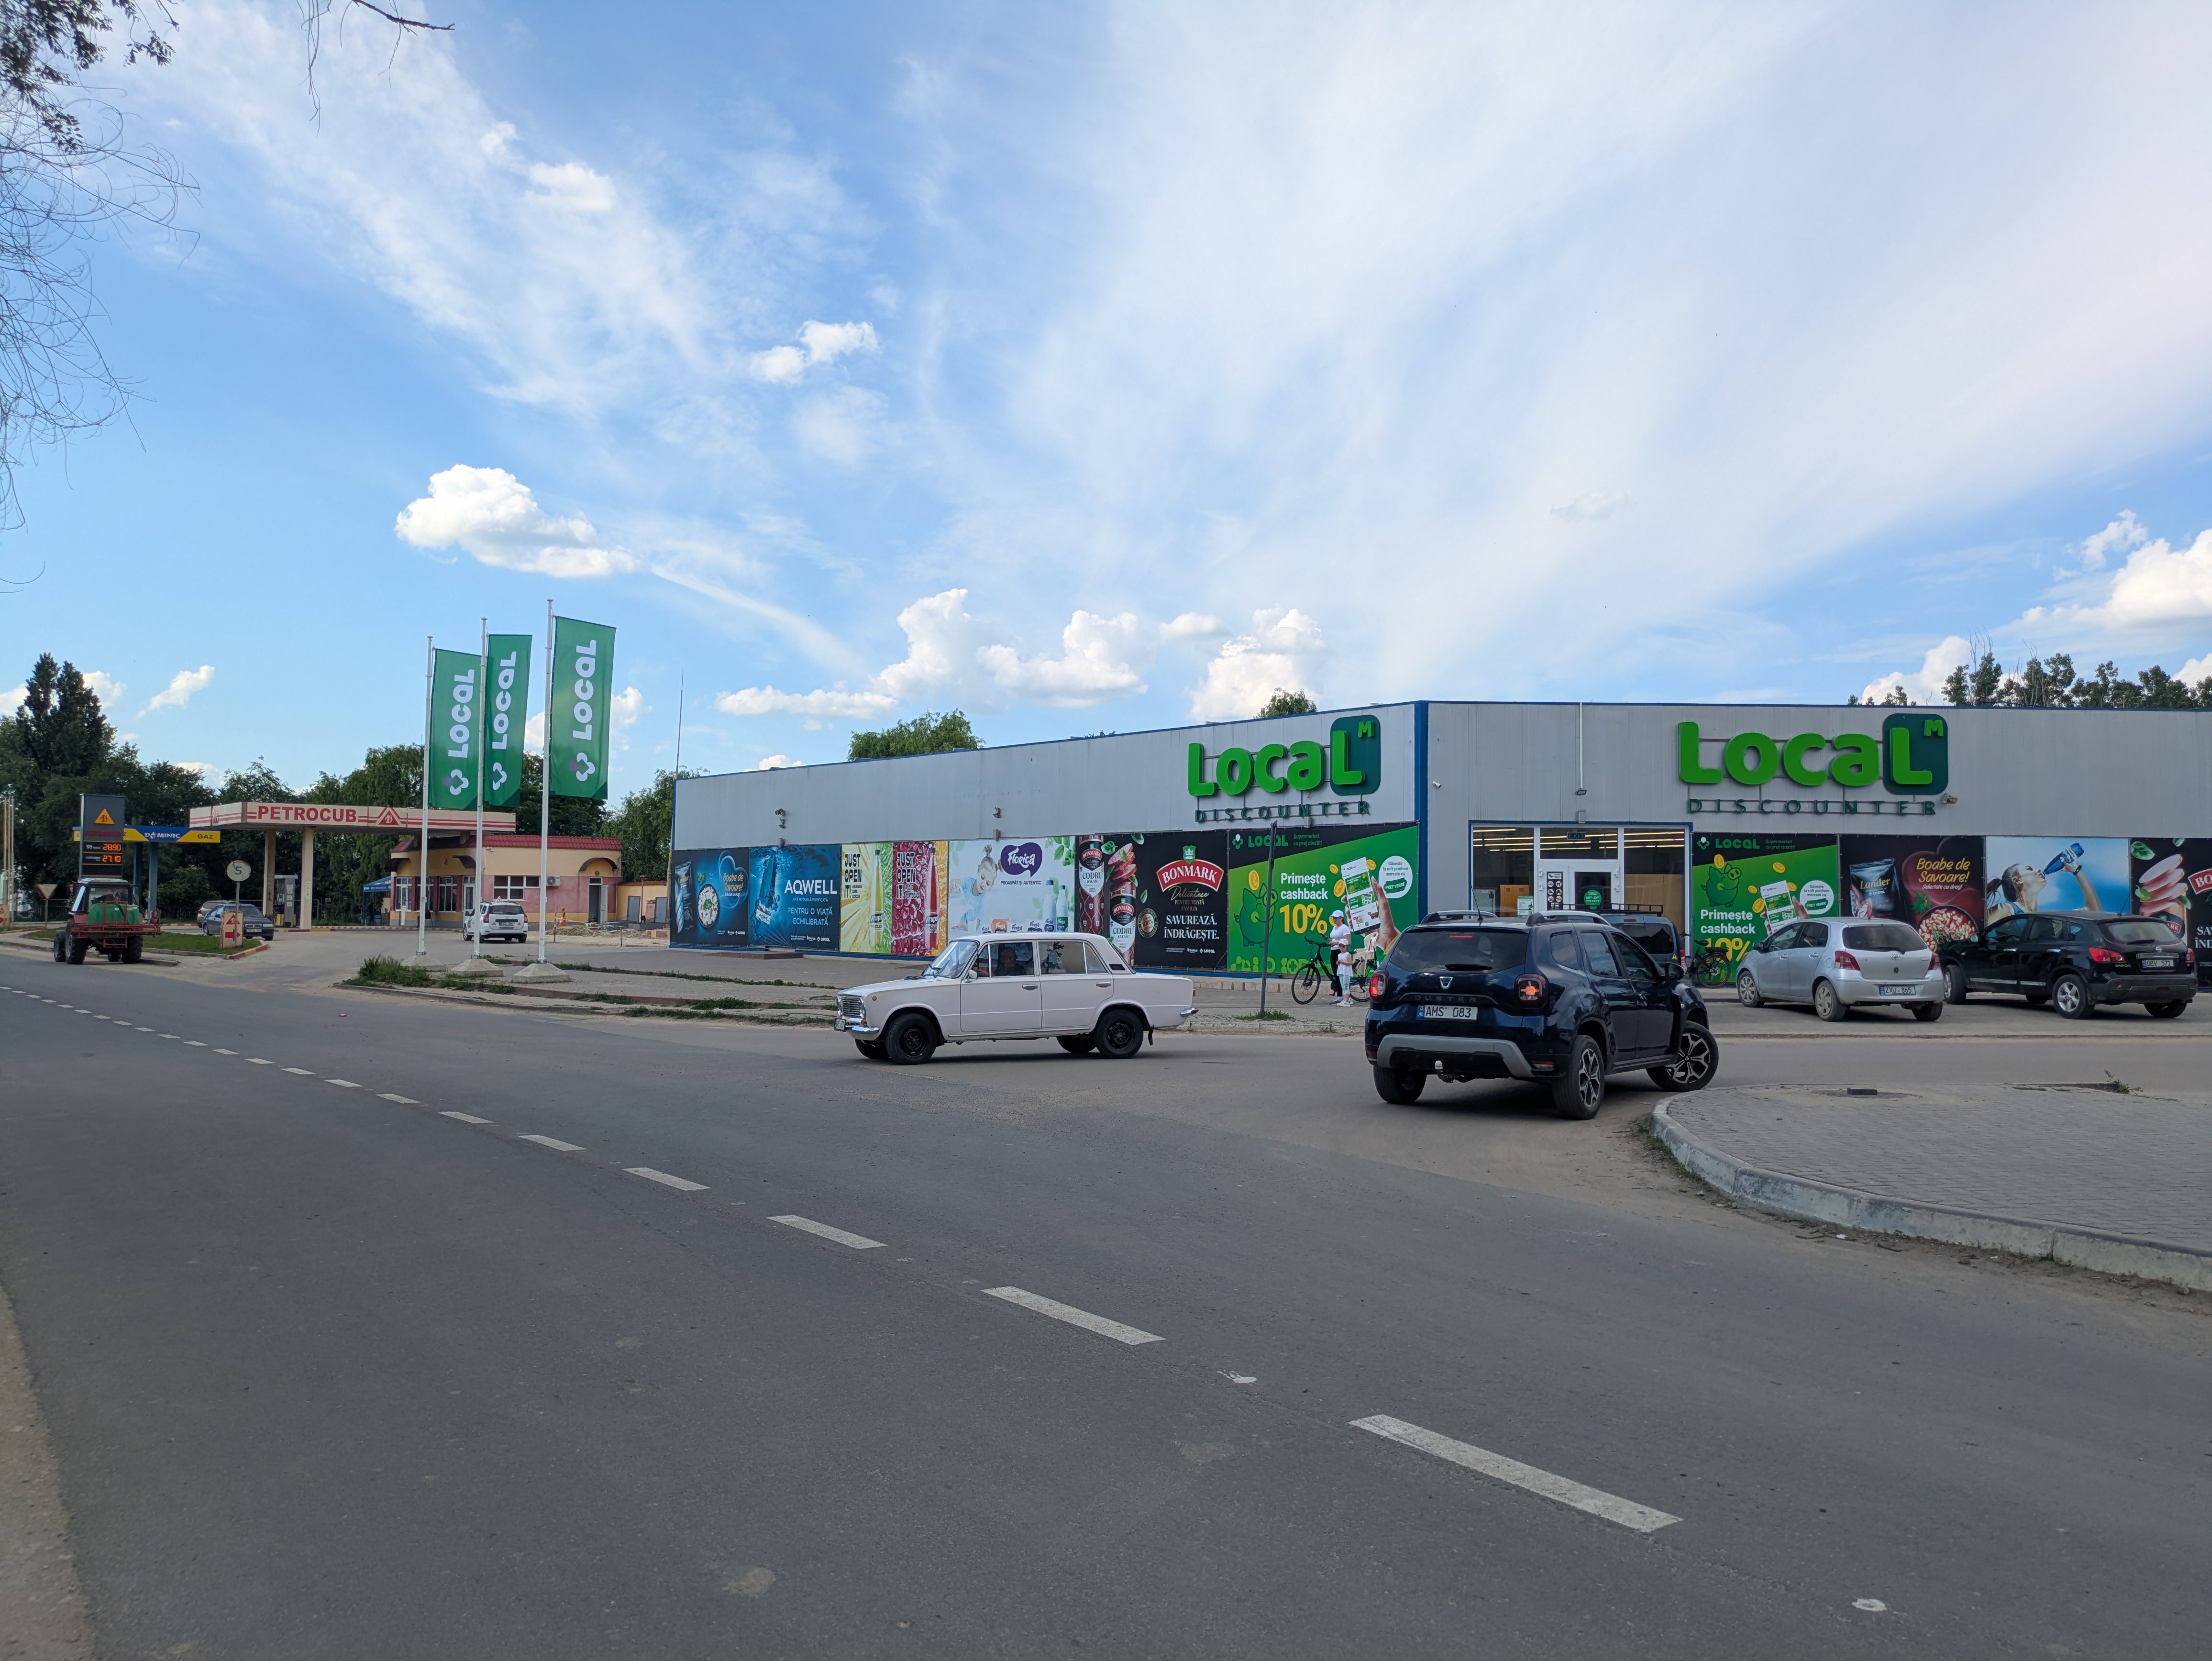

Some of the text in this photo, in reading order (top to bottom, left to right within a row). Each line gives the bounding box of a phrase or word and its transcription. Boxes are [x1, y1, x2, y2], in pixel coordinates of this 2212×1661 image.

[1195, 800, 1370, 823] DISCOUNTER
[1688, 798, 1936, 816] DISCOUNTER
[258, 806, 357, 823] PETROCUB
[845, 853, 861, 867] JUST
[897, 852, 915, 867] JUST
[1007, 847, 1035, 868] Florica
[1083, 851, 1101, 859] BONMARK
[235, 866, 242, 875] 5
[1916, 857, 1970, 871] Boabe de
[844, 869, 862, 883] OPEN
[896, 868, 916, 884] OPEN
[1162, 865, 1218, 884] BONMARK
[1281, 872, 1326, 887] Primește
[1918, 871, 1970, 883] Savoare!
[785, 879, 837, 896] AQWELL
[1860, 878, 1891, 889] Lander
[1168, 886, 1210, 901] Delicatese
[1281, 887, 1328, 900] cashback
[1113, 905, 1133, 913] BONMARK
[1701, 909, 1753, 923] Primește
[793, 918, 829, 926] ECHILIBRATĂ
[1166, 913, 1217, 925] SAVUREAZĂ.
[1279, 904, 1327, 934] 10%
[1164, 926, 1219, 941] ÎNDRĂGEȘTE.
[1701, 923, 1756, 934] cashback
[1425, 1006, 1471, 1018] AMS 083
